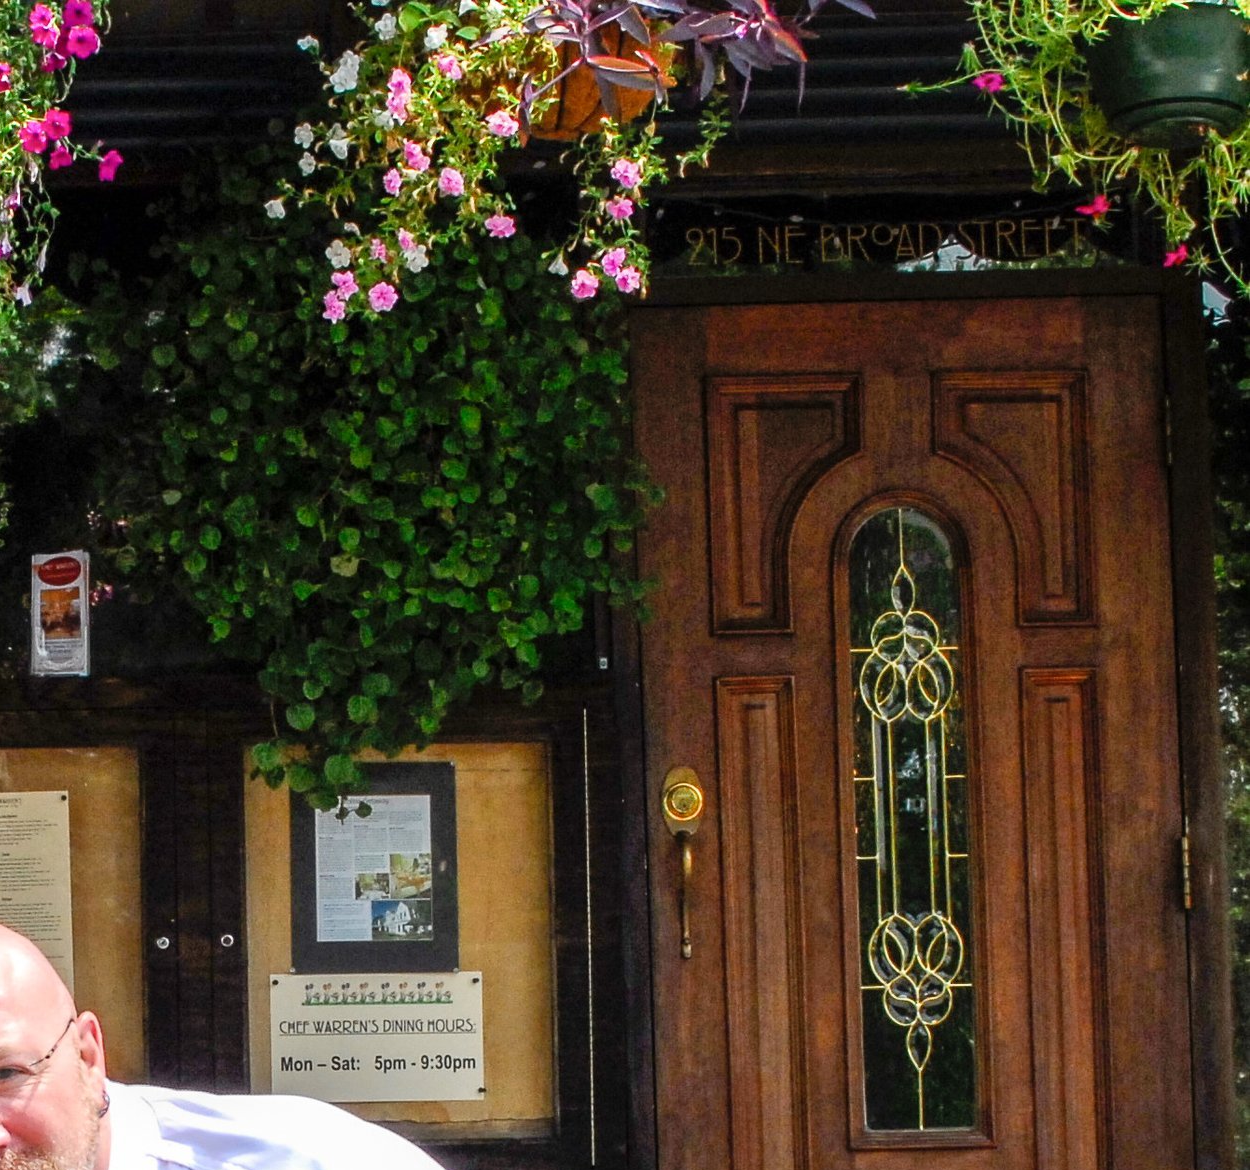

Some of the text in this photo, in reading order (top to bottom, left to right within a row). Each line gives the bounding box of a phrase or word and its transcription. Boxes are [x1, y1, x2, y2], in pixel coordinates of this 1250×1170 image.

[685, 217, 1088, 266] 915 NE BROAD STREET
[279, 1018, 477, 1034] CHEF WARREN'S DINING HOURS:
[280, 1057, 313, 1072] Mon
[331, 1056, 361, 1071] Sat:
[374, 1055, 407, 1074] 5pm
[420, 1054, 476, 1074] 9:30pm
